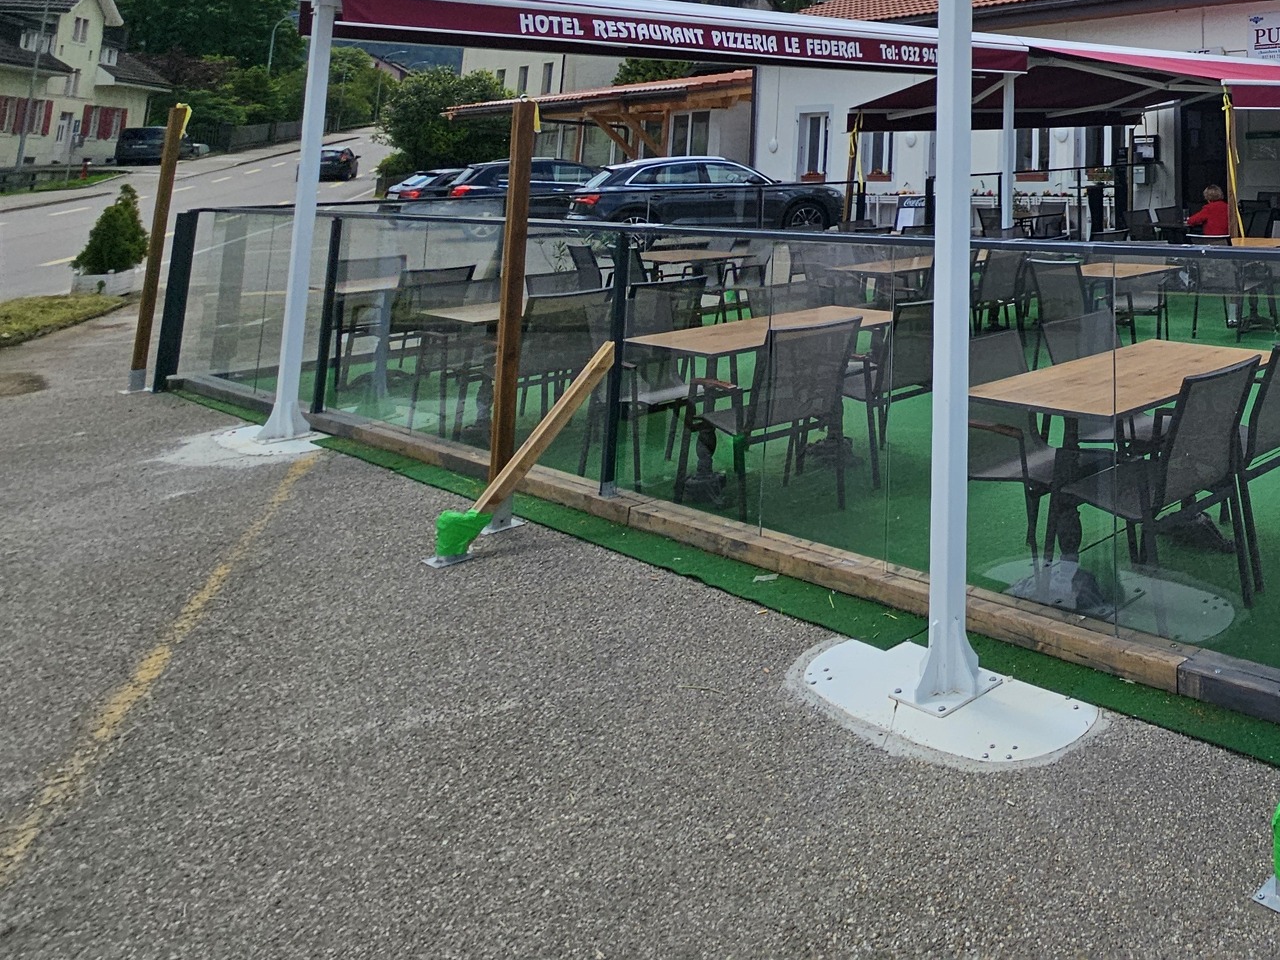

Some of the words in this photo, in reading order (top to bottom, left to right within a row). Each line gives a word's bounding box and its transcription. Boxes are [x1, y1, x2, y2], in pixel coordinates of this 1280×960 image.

[519, 13, 584, 36] HOTEL
[592, 19, 704, 45] RESTAURANT
[711, 30, 778, 53] PIZZERIA
[784, 36, 800, 54] LE
[806, 38, 863, 59] FEDERAL
[879, 43, 899, 61] Tel:
[901, 45, 920, 62] 032
